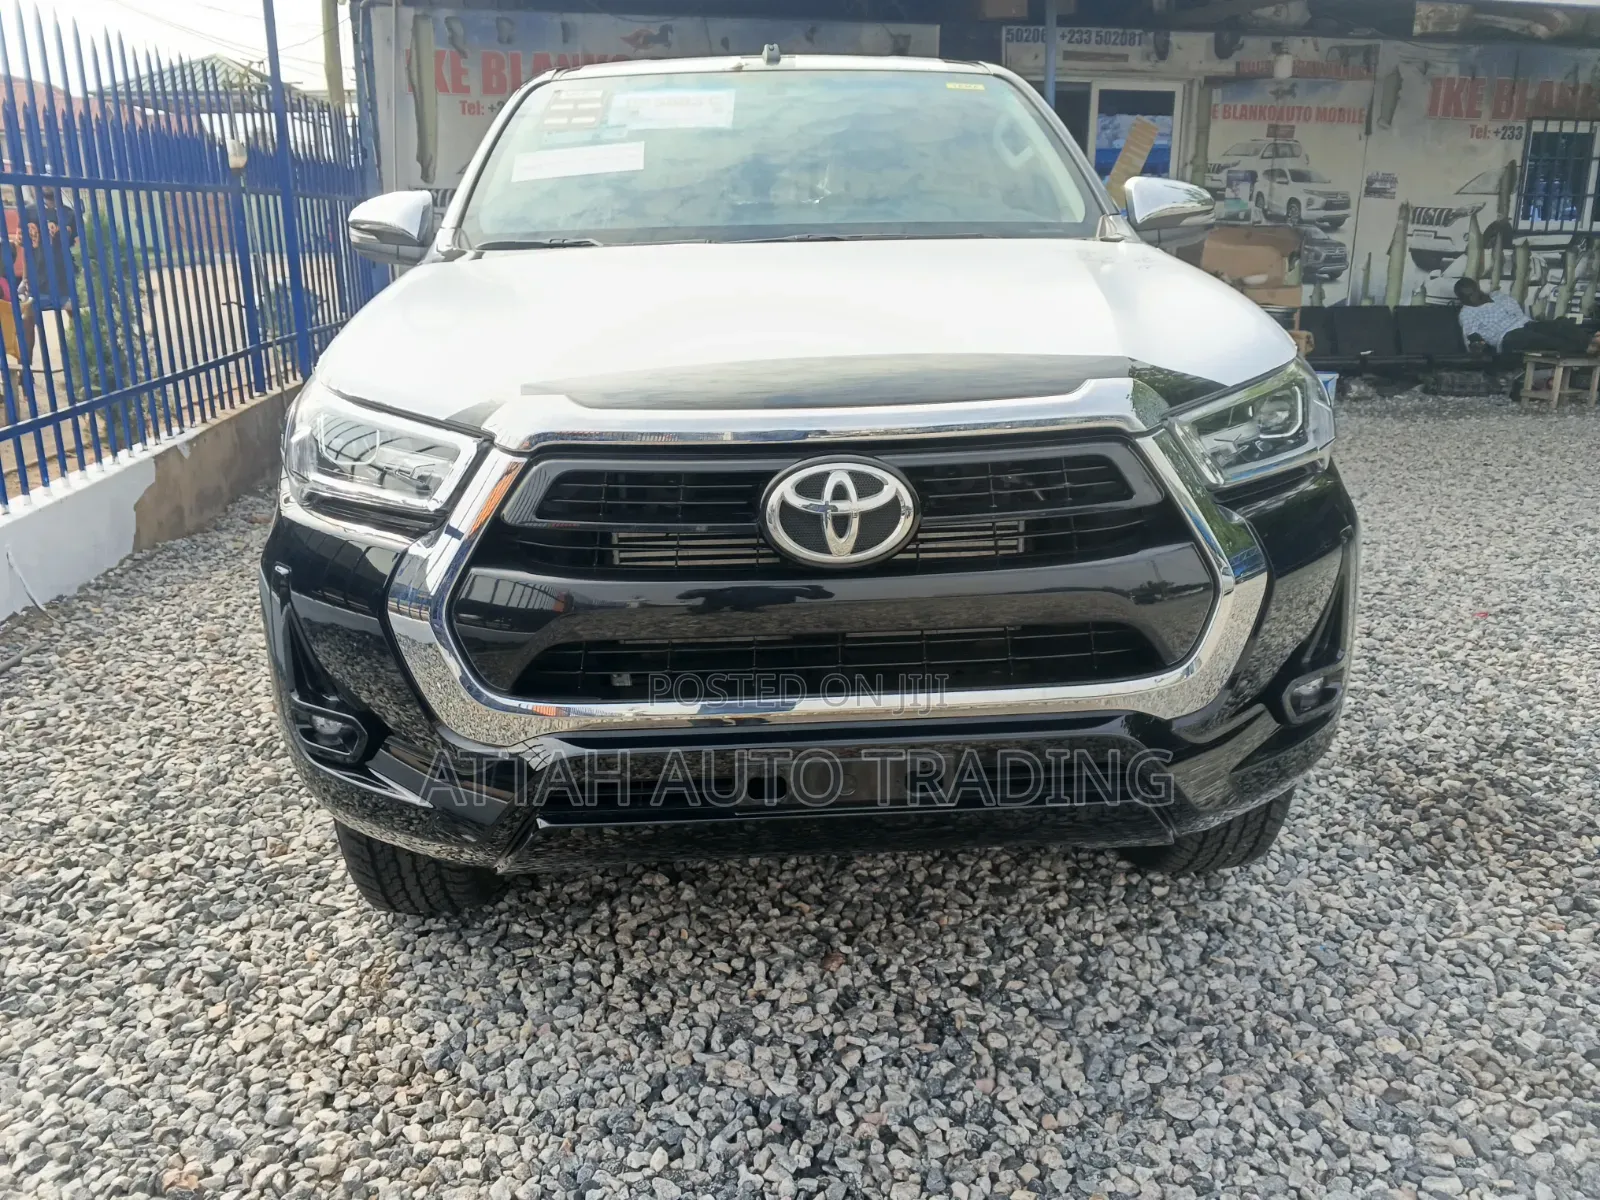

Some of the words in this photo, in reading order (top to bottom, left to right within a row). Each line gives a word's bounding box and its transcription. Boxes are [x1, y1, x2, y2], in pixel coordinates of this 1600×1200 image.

[1060, 29, 1092, 45] +233
[1428, 77, 1487, 119] IKE
[459, 100, 485, 116] Tel:
[1315, 107, 1366, 124] MOBILE
[1469, 124, 1491, 139] Tel:
[1493, 125, 1524, 140] +233
